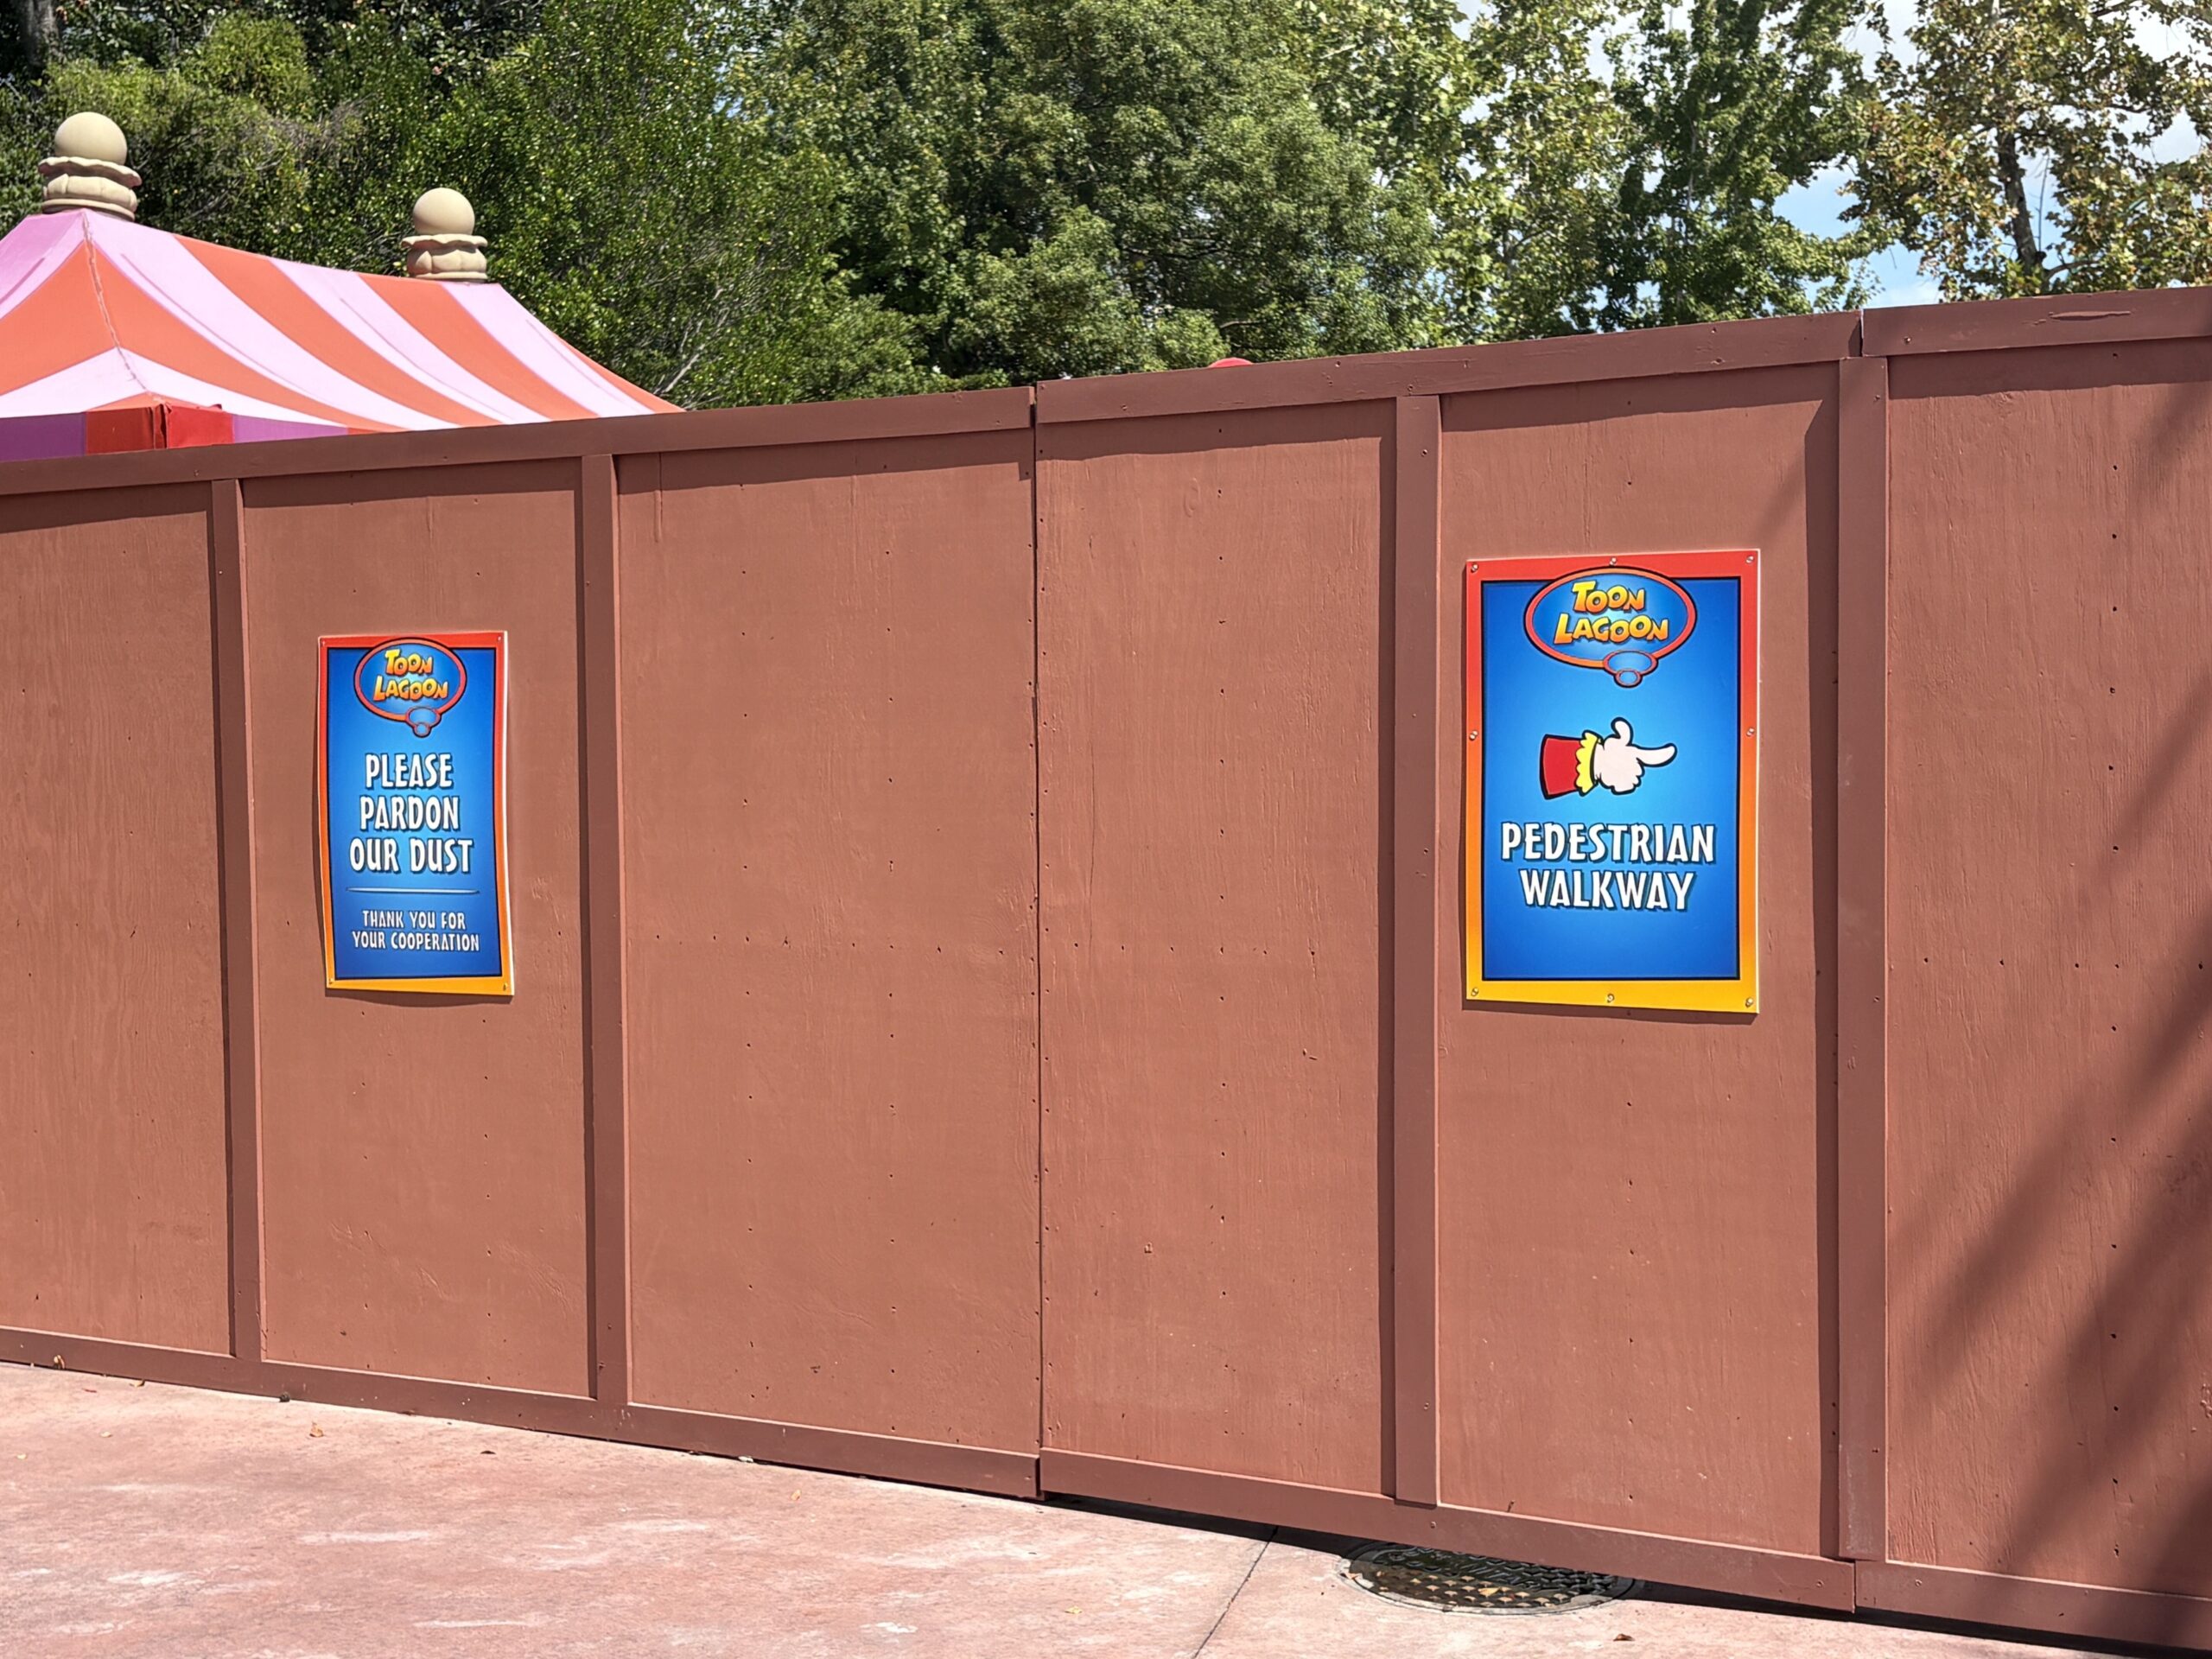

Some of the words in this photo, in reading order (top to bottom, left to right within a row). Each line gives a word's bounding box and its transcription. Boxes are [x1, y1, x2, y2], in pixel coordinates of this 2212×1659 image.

[1571, 580, 1645, 614] TOON
[1554, 613, 1669, 644] LAGOON
[385, 649, 433, 676] TOON
[372, 676, 449, 702] LAGOON
[365, 753, 454, 789] PLEASE
[359, 795, 461, 831] PARDON
[349, 837, 400, 873] OUR
[409, 838, 474, 874] DUST
[1501, 822, 1716, 862] PEDESTRIAN
[1518, 868, 1695, 911] WALKWAY
[362, 910, 404, 928] THANK
[410, 912, 435, 930] YOU
[441, 912, 467, 930] FOR
[352, 931, 386, 949] YOUR
[391, 931, 480, 951] COOPERATION
